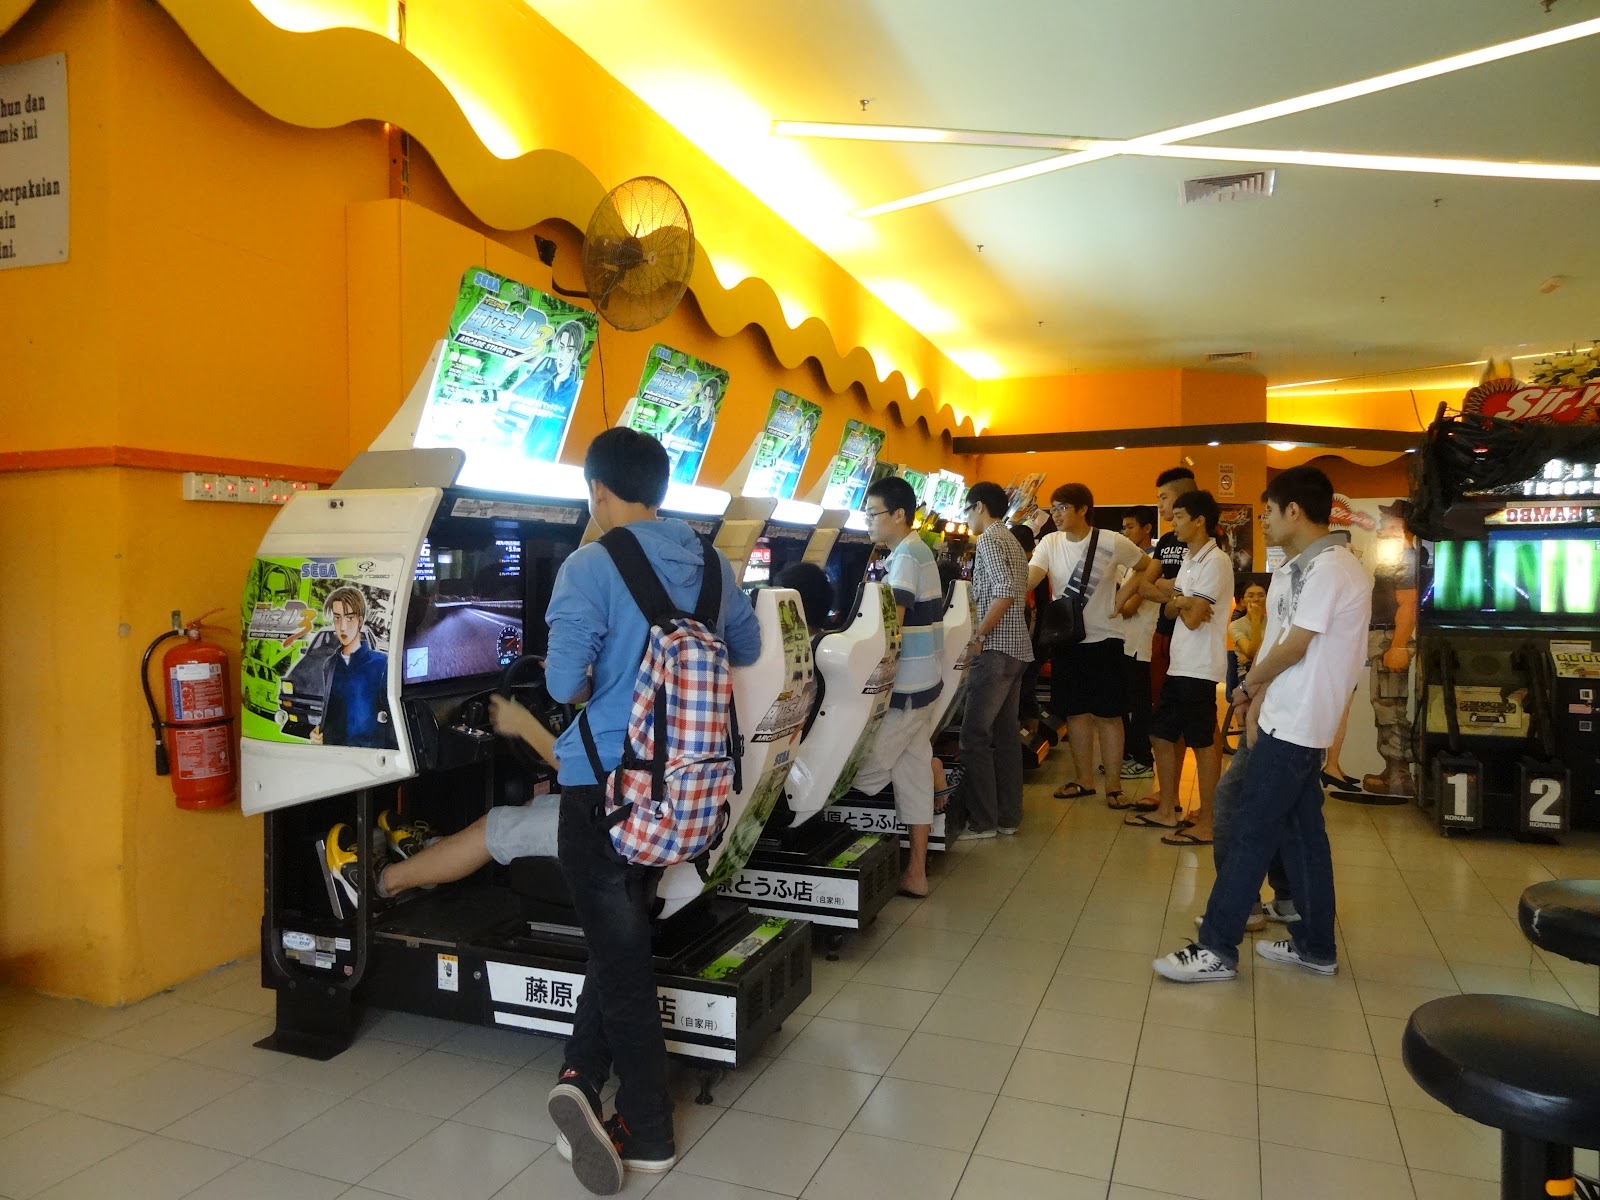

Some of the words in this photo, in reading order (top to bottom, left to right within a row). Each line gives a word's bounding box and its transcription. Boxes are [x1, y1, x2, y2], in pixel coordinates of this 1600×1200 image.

[25, 93, 46, 113] dan
[22, 119, 38, 140] ini
[475, 272, 500, 293] SEGA
[458, 335, 486, 349] ARCADE
[484, 343, 507, 356] STAGE
[1160, 546, 1190, 557] POLICE
[301, 563, 338, 578] SEGA
[1447, 773, 1468, 816] 1
[1529, 778, 1561, 823] 2
